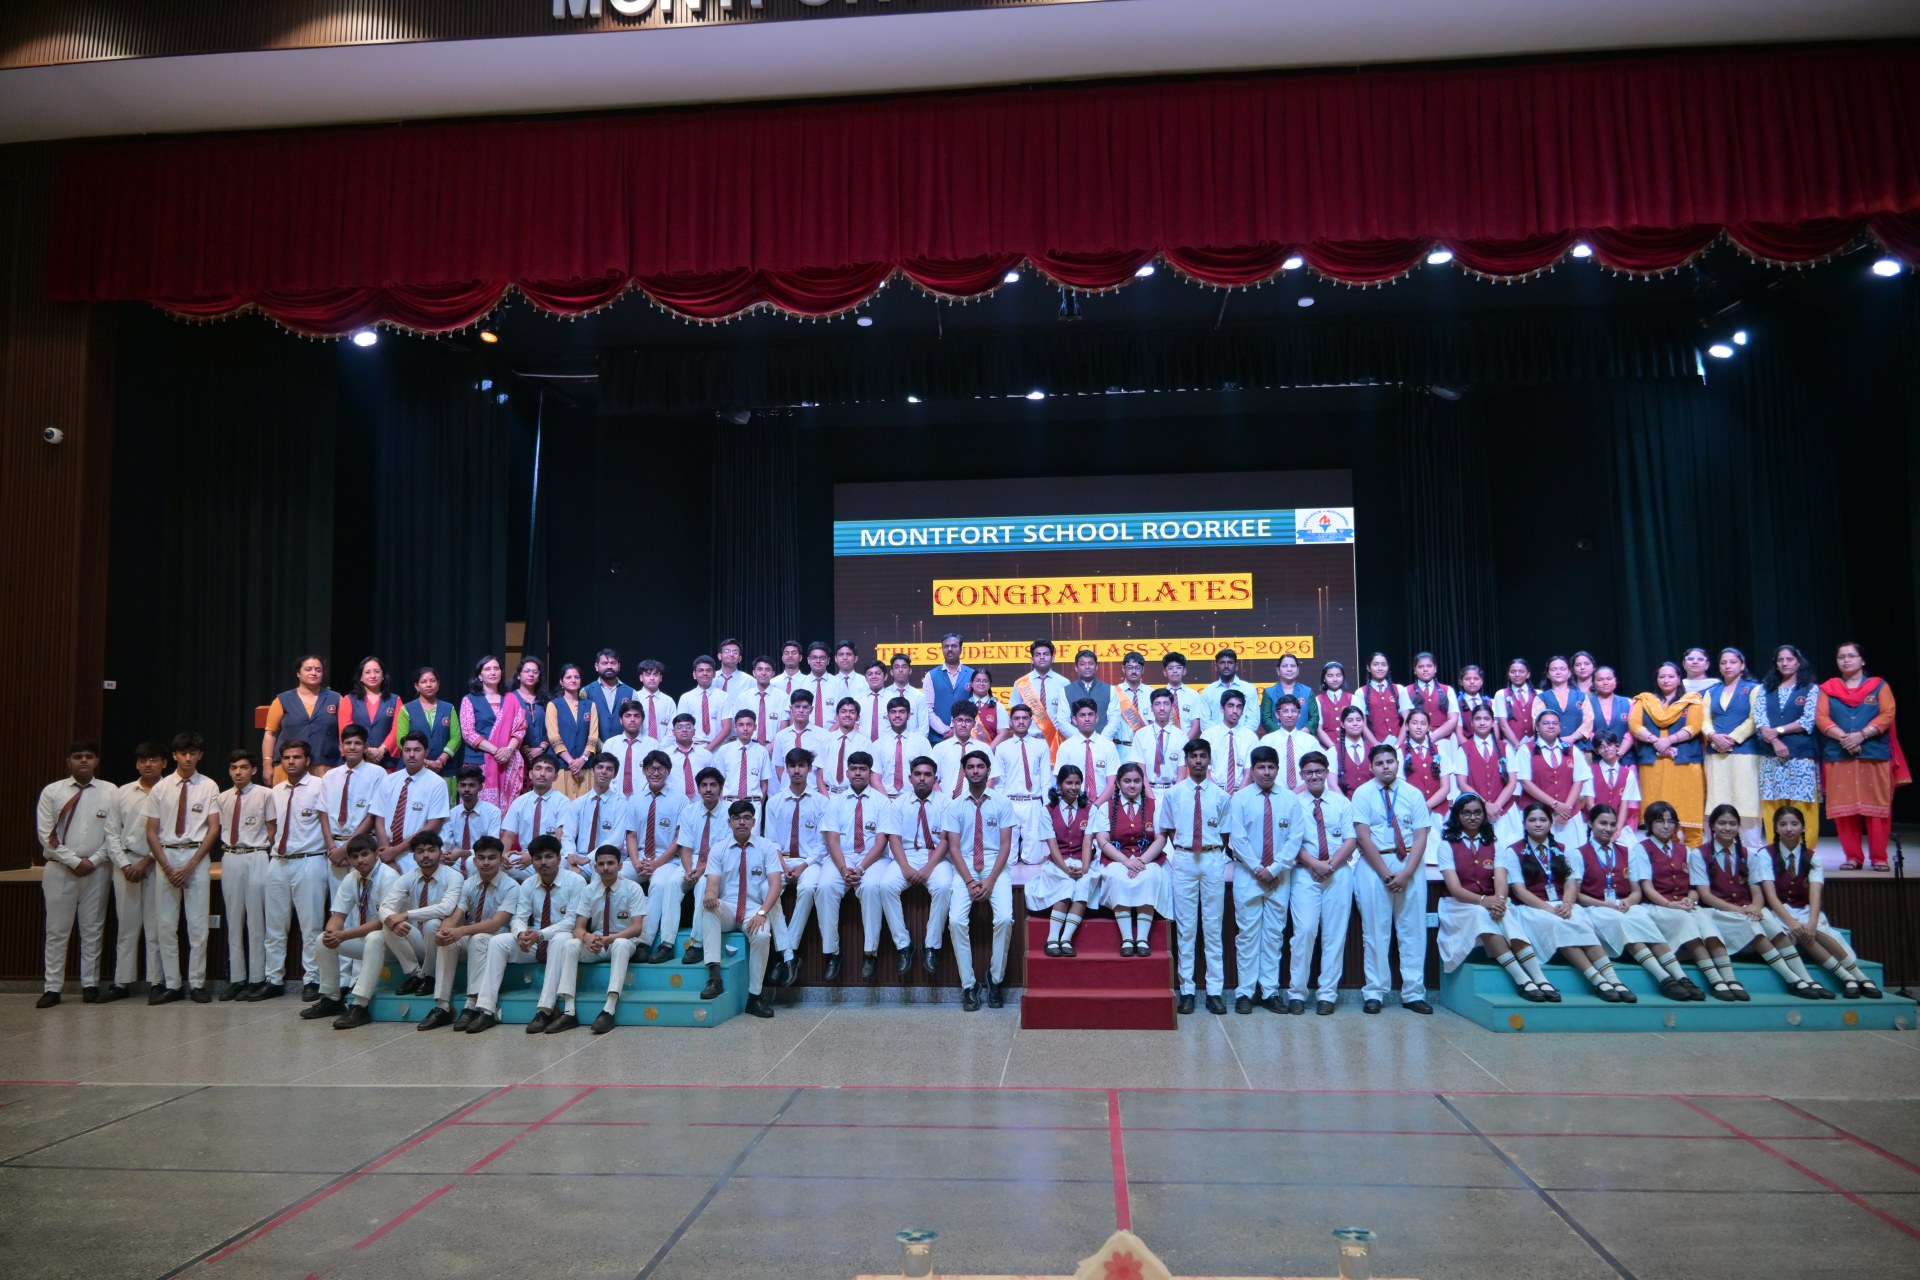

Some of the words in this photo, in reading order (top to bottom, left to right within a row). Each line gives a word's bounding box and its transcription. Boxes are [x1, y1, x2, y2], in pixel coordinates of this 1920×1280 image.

[860, 525, 1015, 547] MONTFORT
[1023, 522, 1133, 543] SCHOOL
[1142, 519, 1272, 540] ROORKEE
[933, 579, 1251, 607] CONGRATULATES
